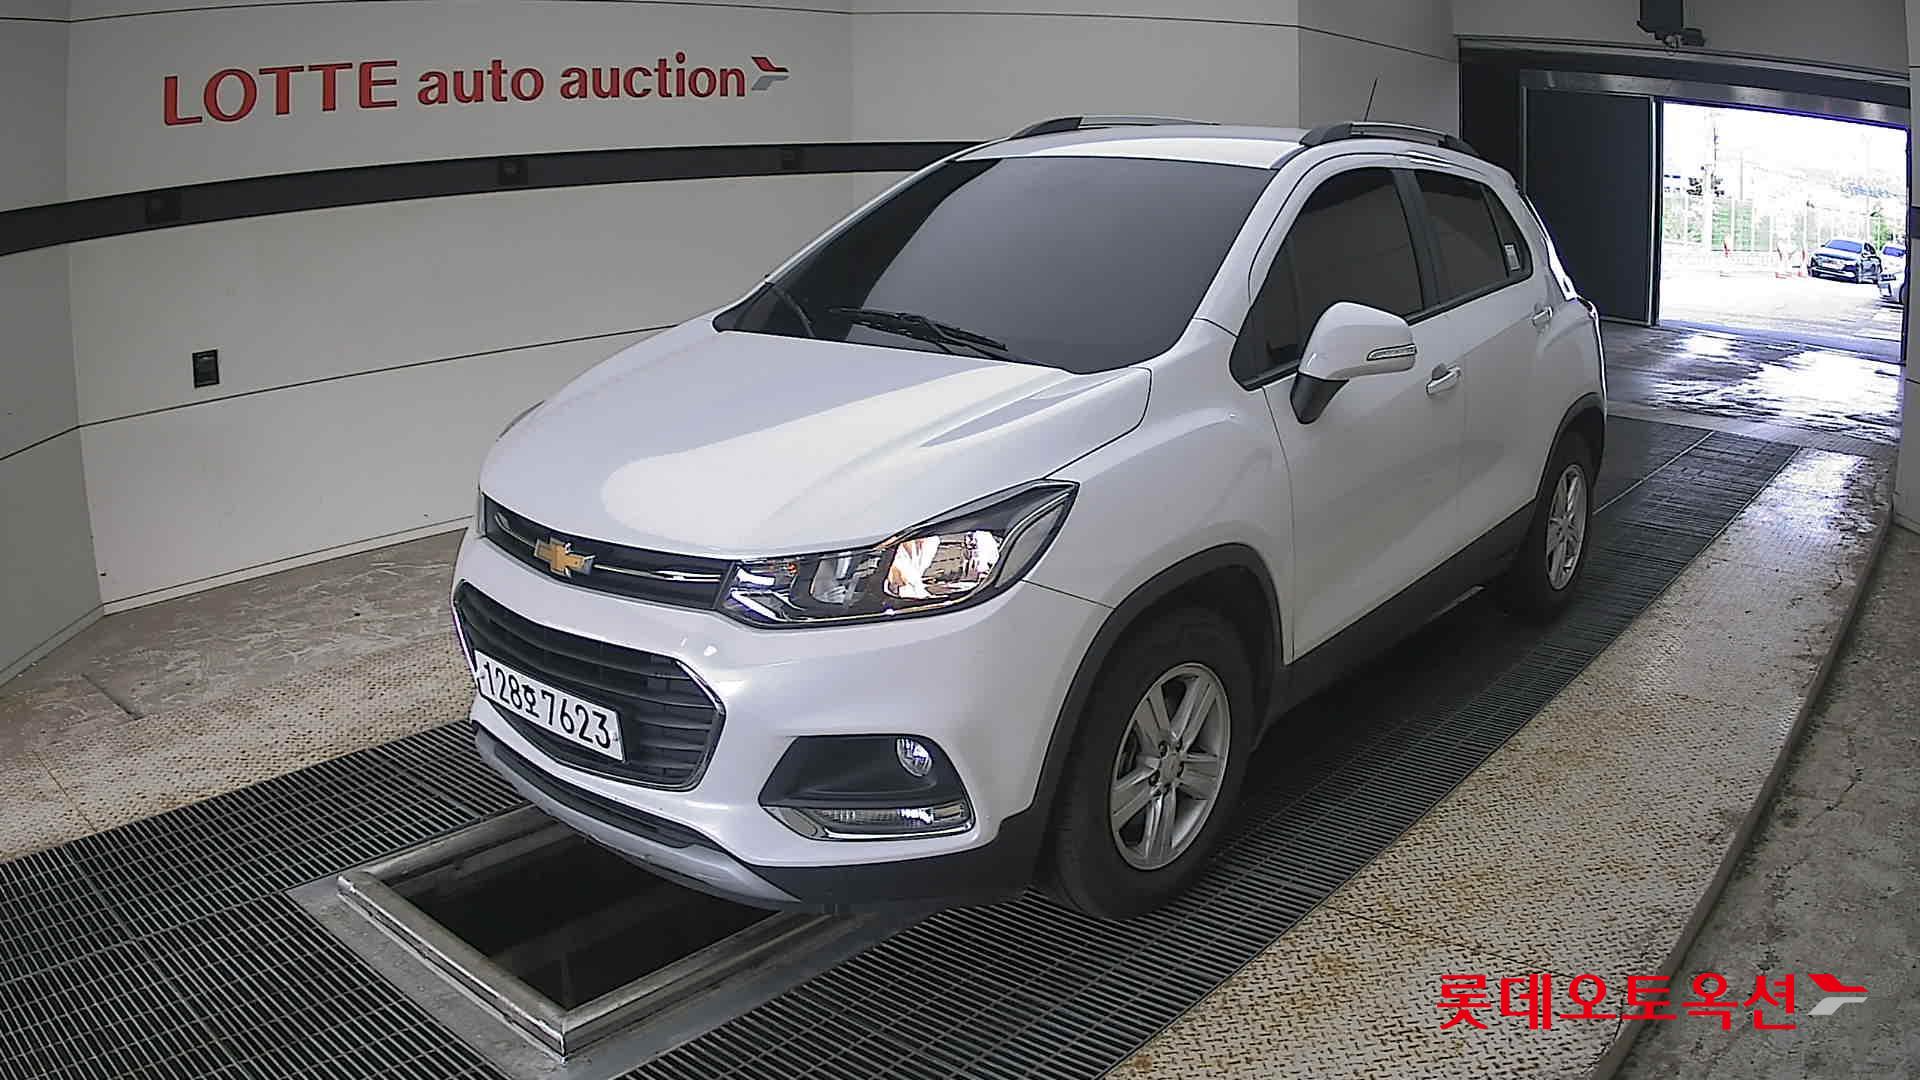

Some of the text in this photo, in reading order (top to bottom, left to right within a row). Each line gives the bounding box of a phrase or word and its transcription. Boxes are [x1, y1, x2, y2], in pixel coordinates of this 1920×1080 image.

[163, 51, 747, 126] LOTTE auto auction
